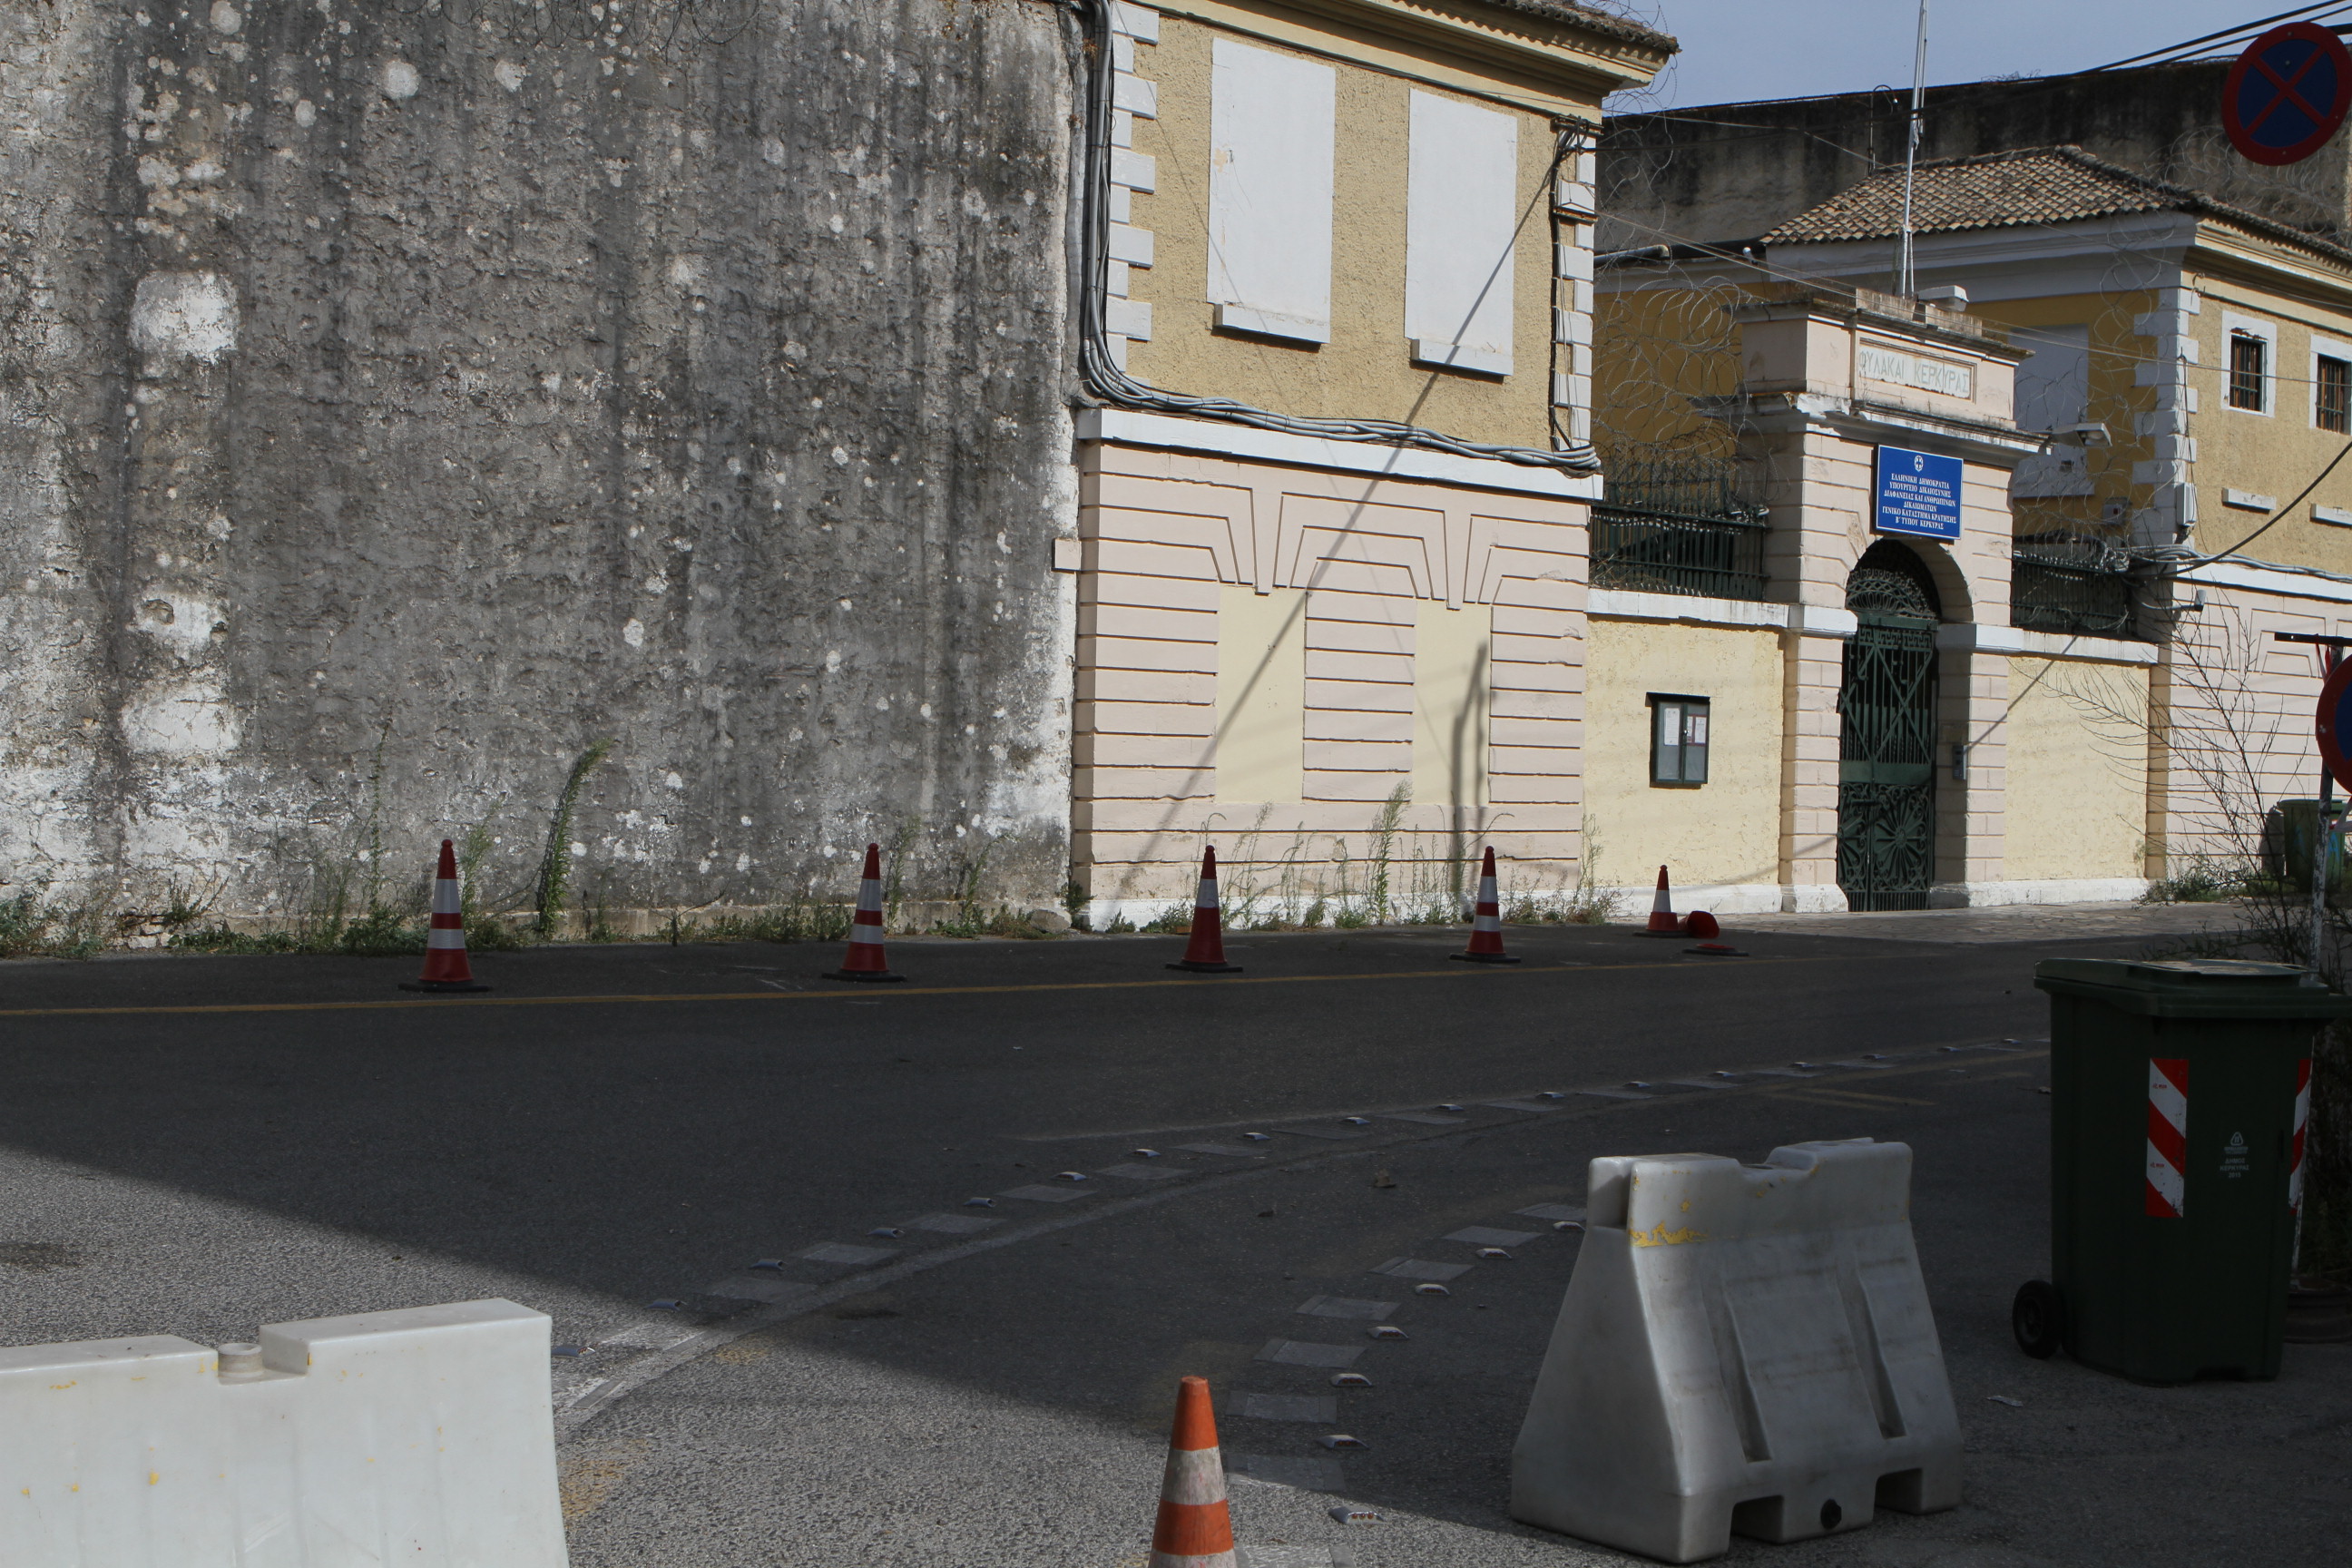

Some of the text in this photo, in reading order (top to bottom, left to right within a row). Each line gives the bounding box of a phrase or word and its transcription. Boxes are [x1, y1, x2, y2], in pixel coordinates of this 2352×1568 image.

[1858, 350, 1969, 393] ΦΥΛΑΚΑΙ ΚΕΡΚΥΡΑΣ
[1889, 481, 1952, 498] ΥΠΟΥΡΓΕΙΟ ΔΙΚΑΙΟΣΥΝΗΣ
[1891, 473, 1950, 489] ΕΛΛΗΝΙΚΗ ΔΗΜΟΚΡΑΤΙΑ
[1884, 489, 1955, 507] ΔΙΑΦΑΝΕΙΑΣ ΚΑΙ ΑΝΘΡΩΠΙΝΩΝ
[1882, 506, 1957, 524] ΓΕΝΙΚΟ ΚΑΤΑΣΤΗΜΑ ΚΡΑΤΗΣΗΣ
[1904, 501, 1937, 513] ΔΙΚΑΙΩΜΑΤΩΝ
[1901, 517, 1919, 526] ΤΥΠΟΥ
[1920, 520, 1945, 530] ΚΕΡΚΥΡΑΣ
